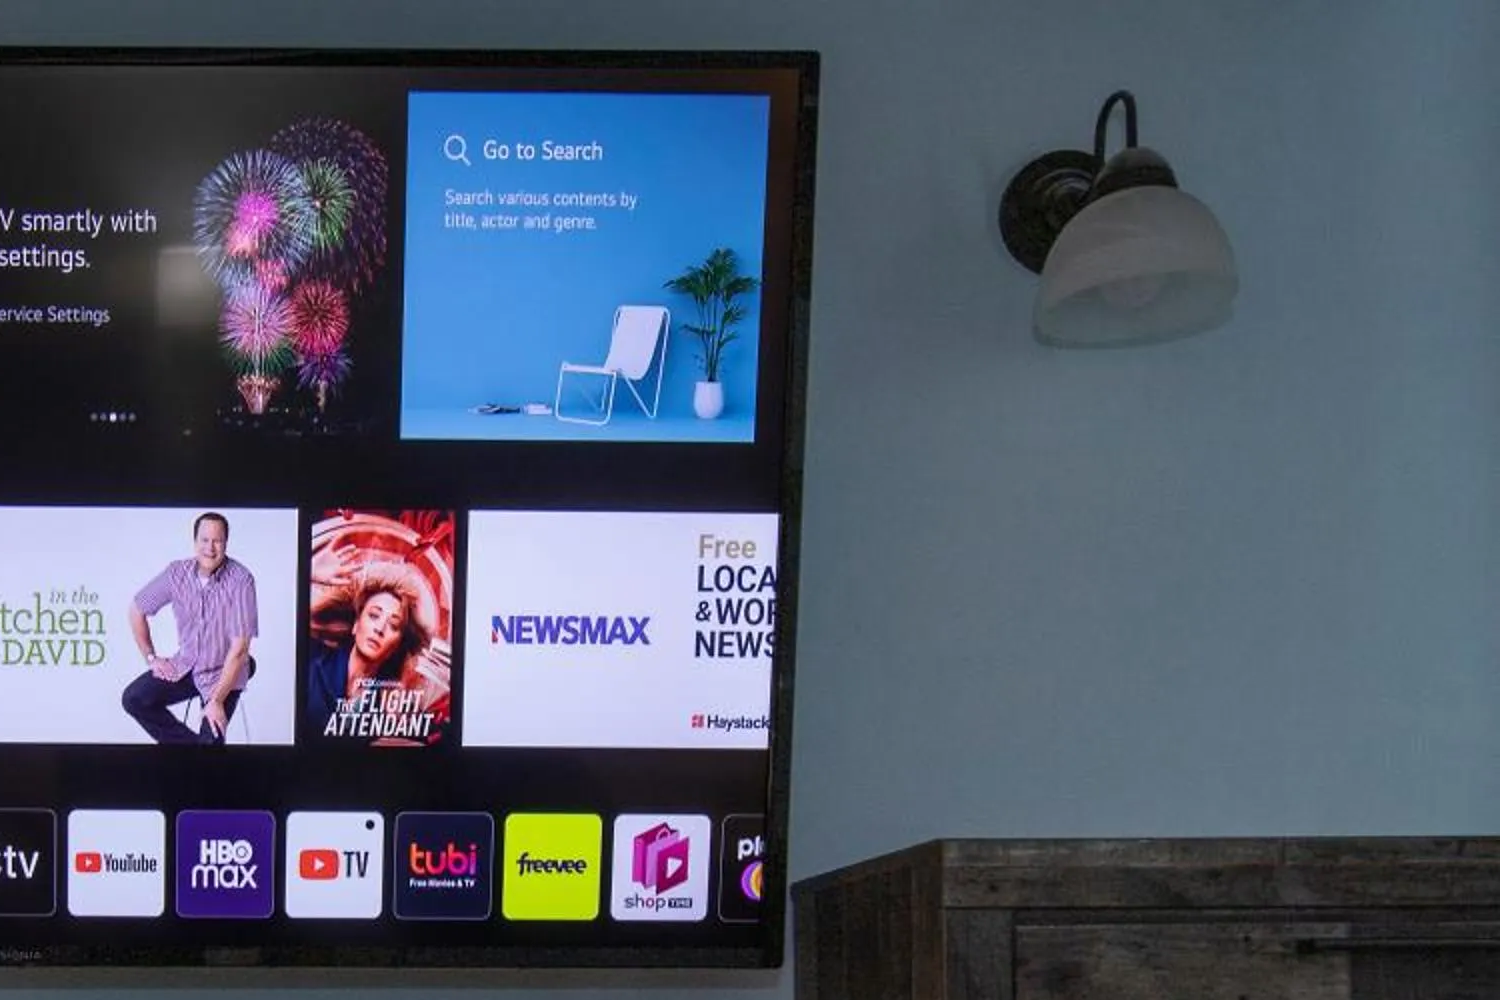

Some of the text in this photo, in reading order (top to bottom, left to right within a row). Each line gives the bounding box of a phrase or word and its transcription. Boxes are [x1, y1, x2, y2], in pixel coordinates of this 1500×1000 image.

[484, 141, 603, 161] Go to Search
[445, 189, 637, 210] Search various contents by
[22, 209, 103, 237] smartly
[111, 209, 157, 233] with
[481, 215, 518, 229] actor
[523, 213, 550, 229] and
[47, 306, 110, 326] Settings
[699, 534, 757, 559] Free
[50, 585, 99, 604] in the
[492, 615, 650, 645] NEWSMAX
[2, 639, 106, 665] DAVID
[695, 631, 775, 658] NEWS
[359, 689, 425, 713] FLIGHT
[323, 713, 434, 737] ATTENDANT
[707, 715, 771, 733] Haystack
[4, 846, 39, 878] tv
[104, 853, 157, 873] YouTube
[200, 839, 253, 865] HBO
[344, 851, 369, 877] TV
[409, 843, 477, 875] tubi
[517, 853, 586, 875] freevee
[192, 865, 257, 888] max
[624, 892, 666, 912] shop
